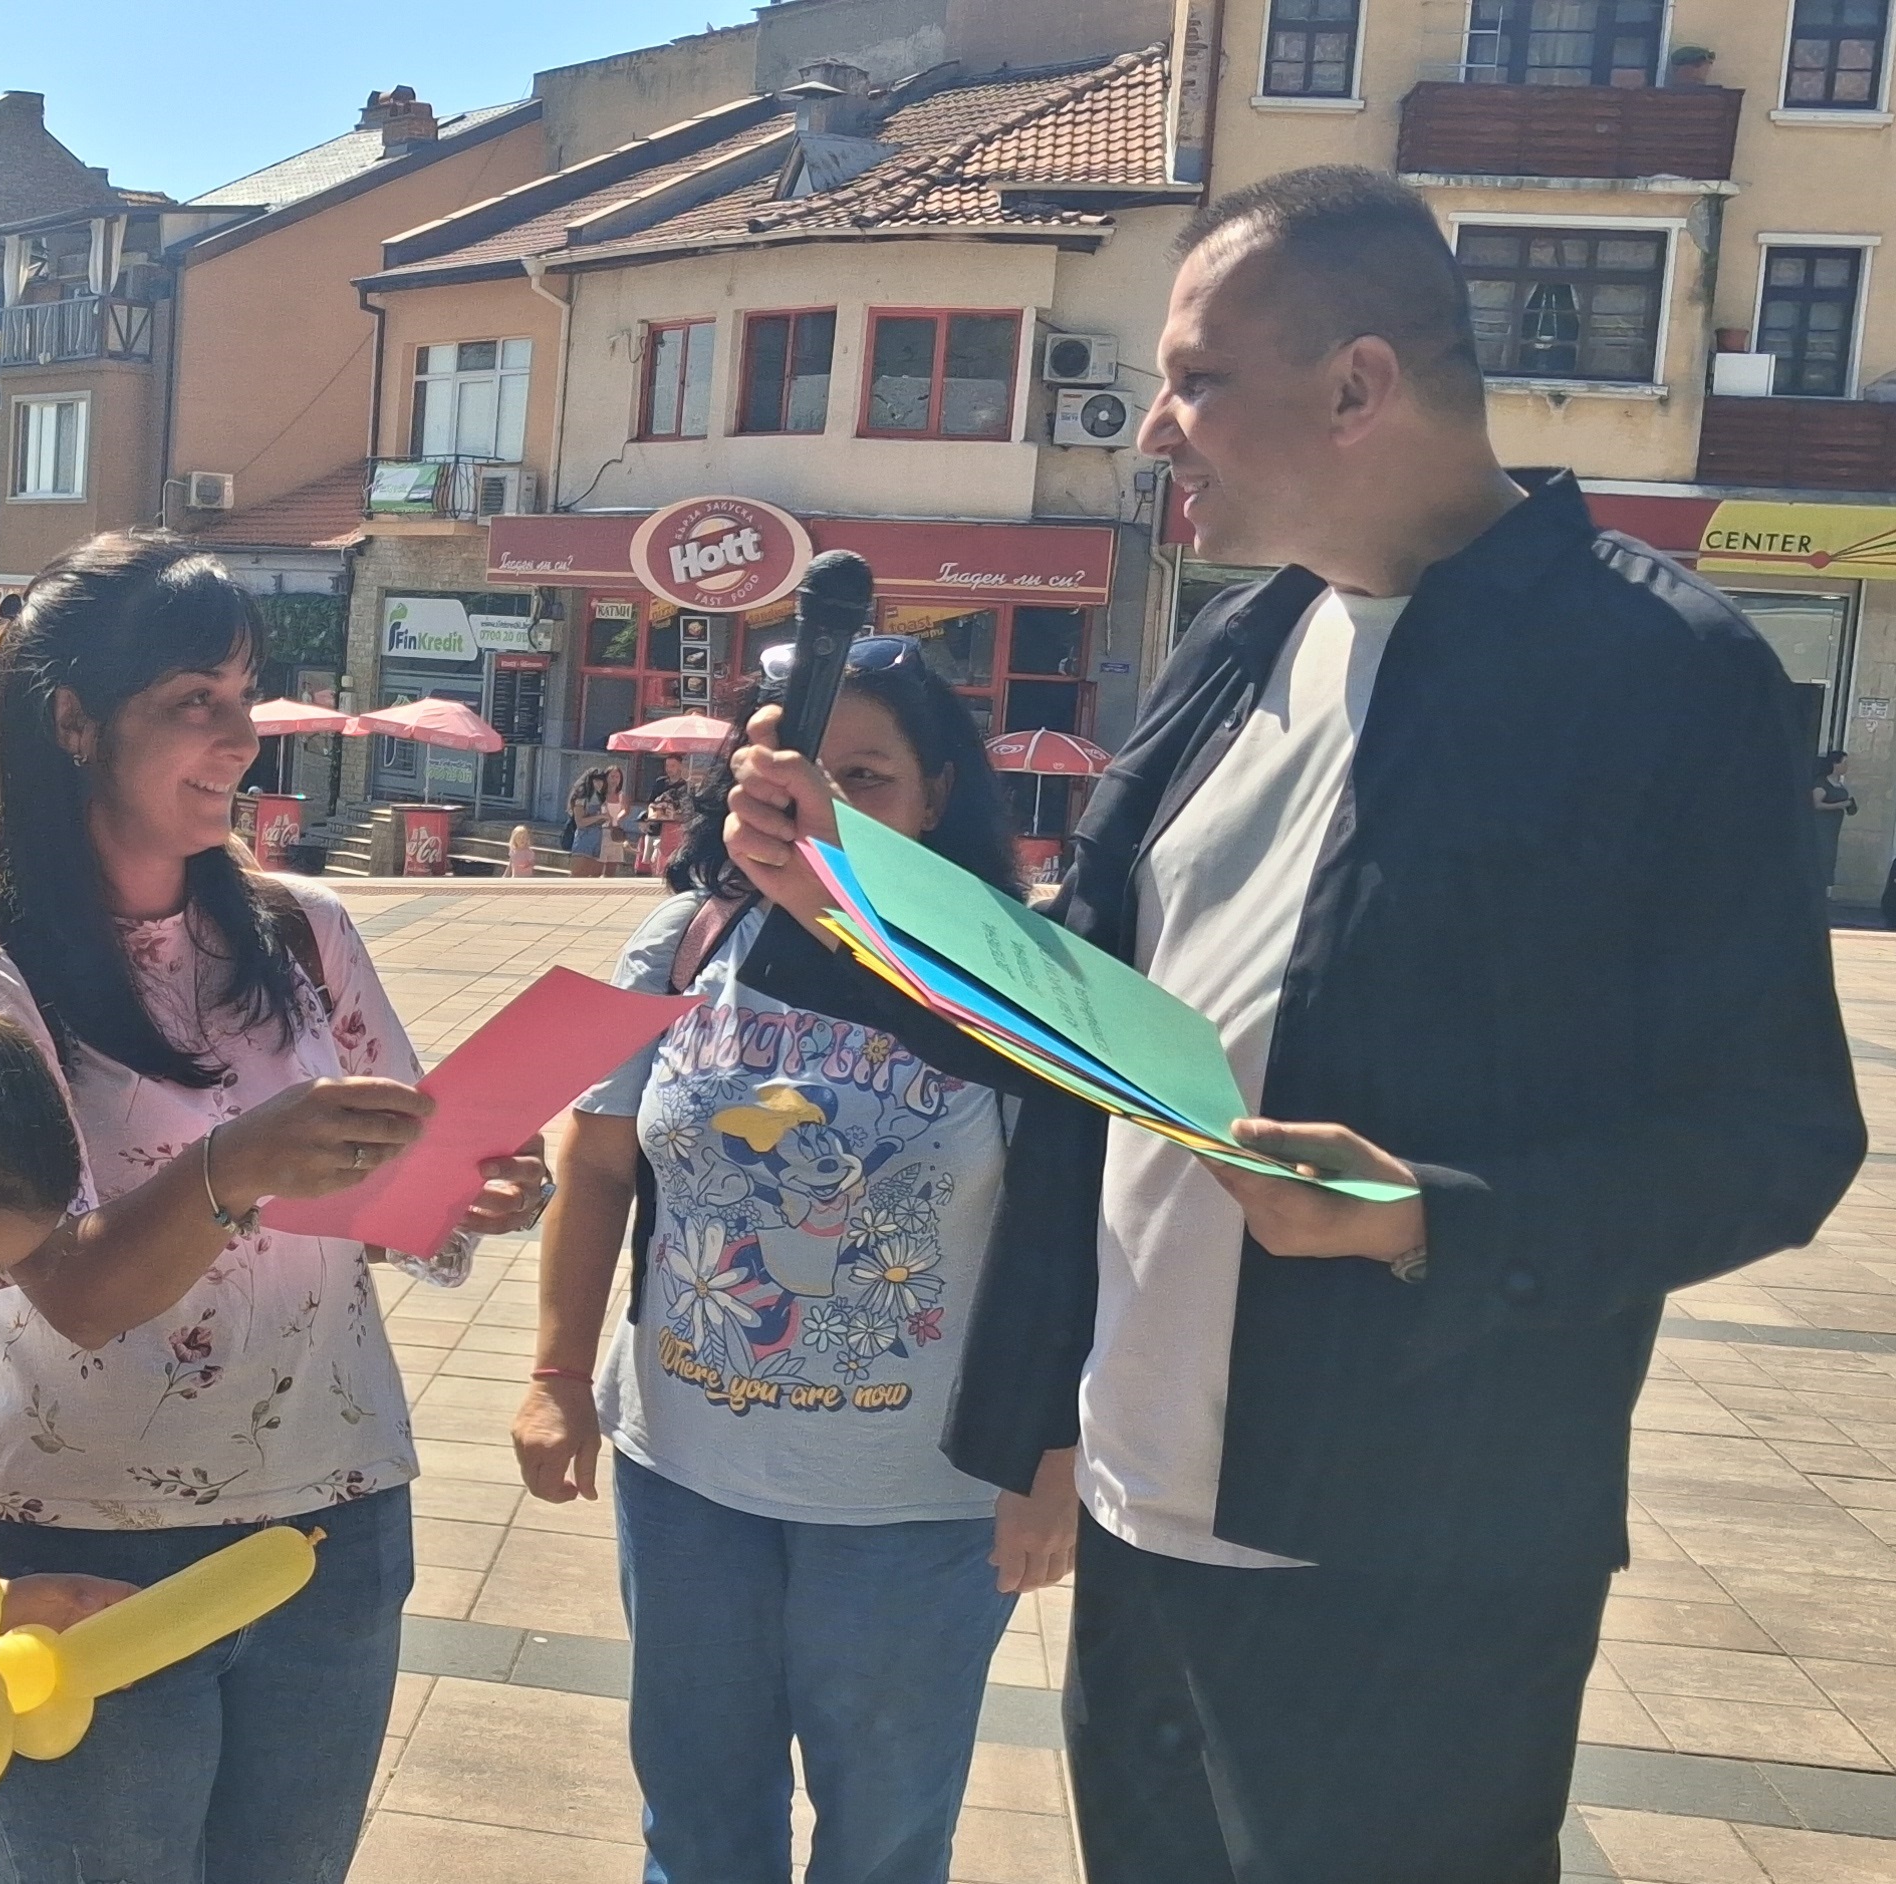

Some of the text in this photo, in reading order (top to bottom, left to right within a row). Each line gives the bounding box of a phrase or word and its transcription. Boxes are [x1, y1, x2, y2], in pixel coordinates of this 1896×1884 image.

[706, 501, 754, 523] ЗАКУСКА
[669, 527, 764, 584] Hott
[1706, 530, 1812, 553] CENTER
[695, 574, 760, 606] FAST FOOD
[935, 562, 1086, 590] Гладен ли си?
[395, 629, 464, 653] FinKredit
[659, 1326, 912, 1416] Where you are now
